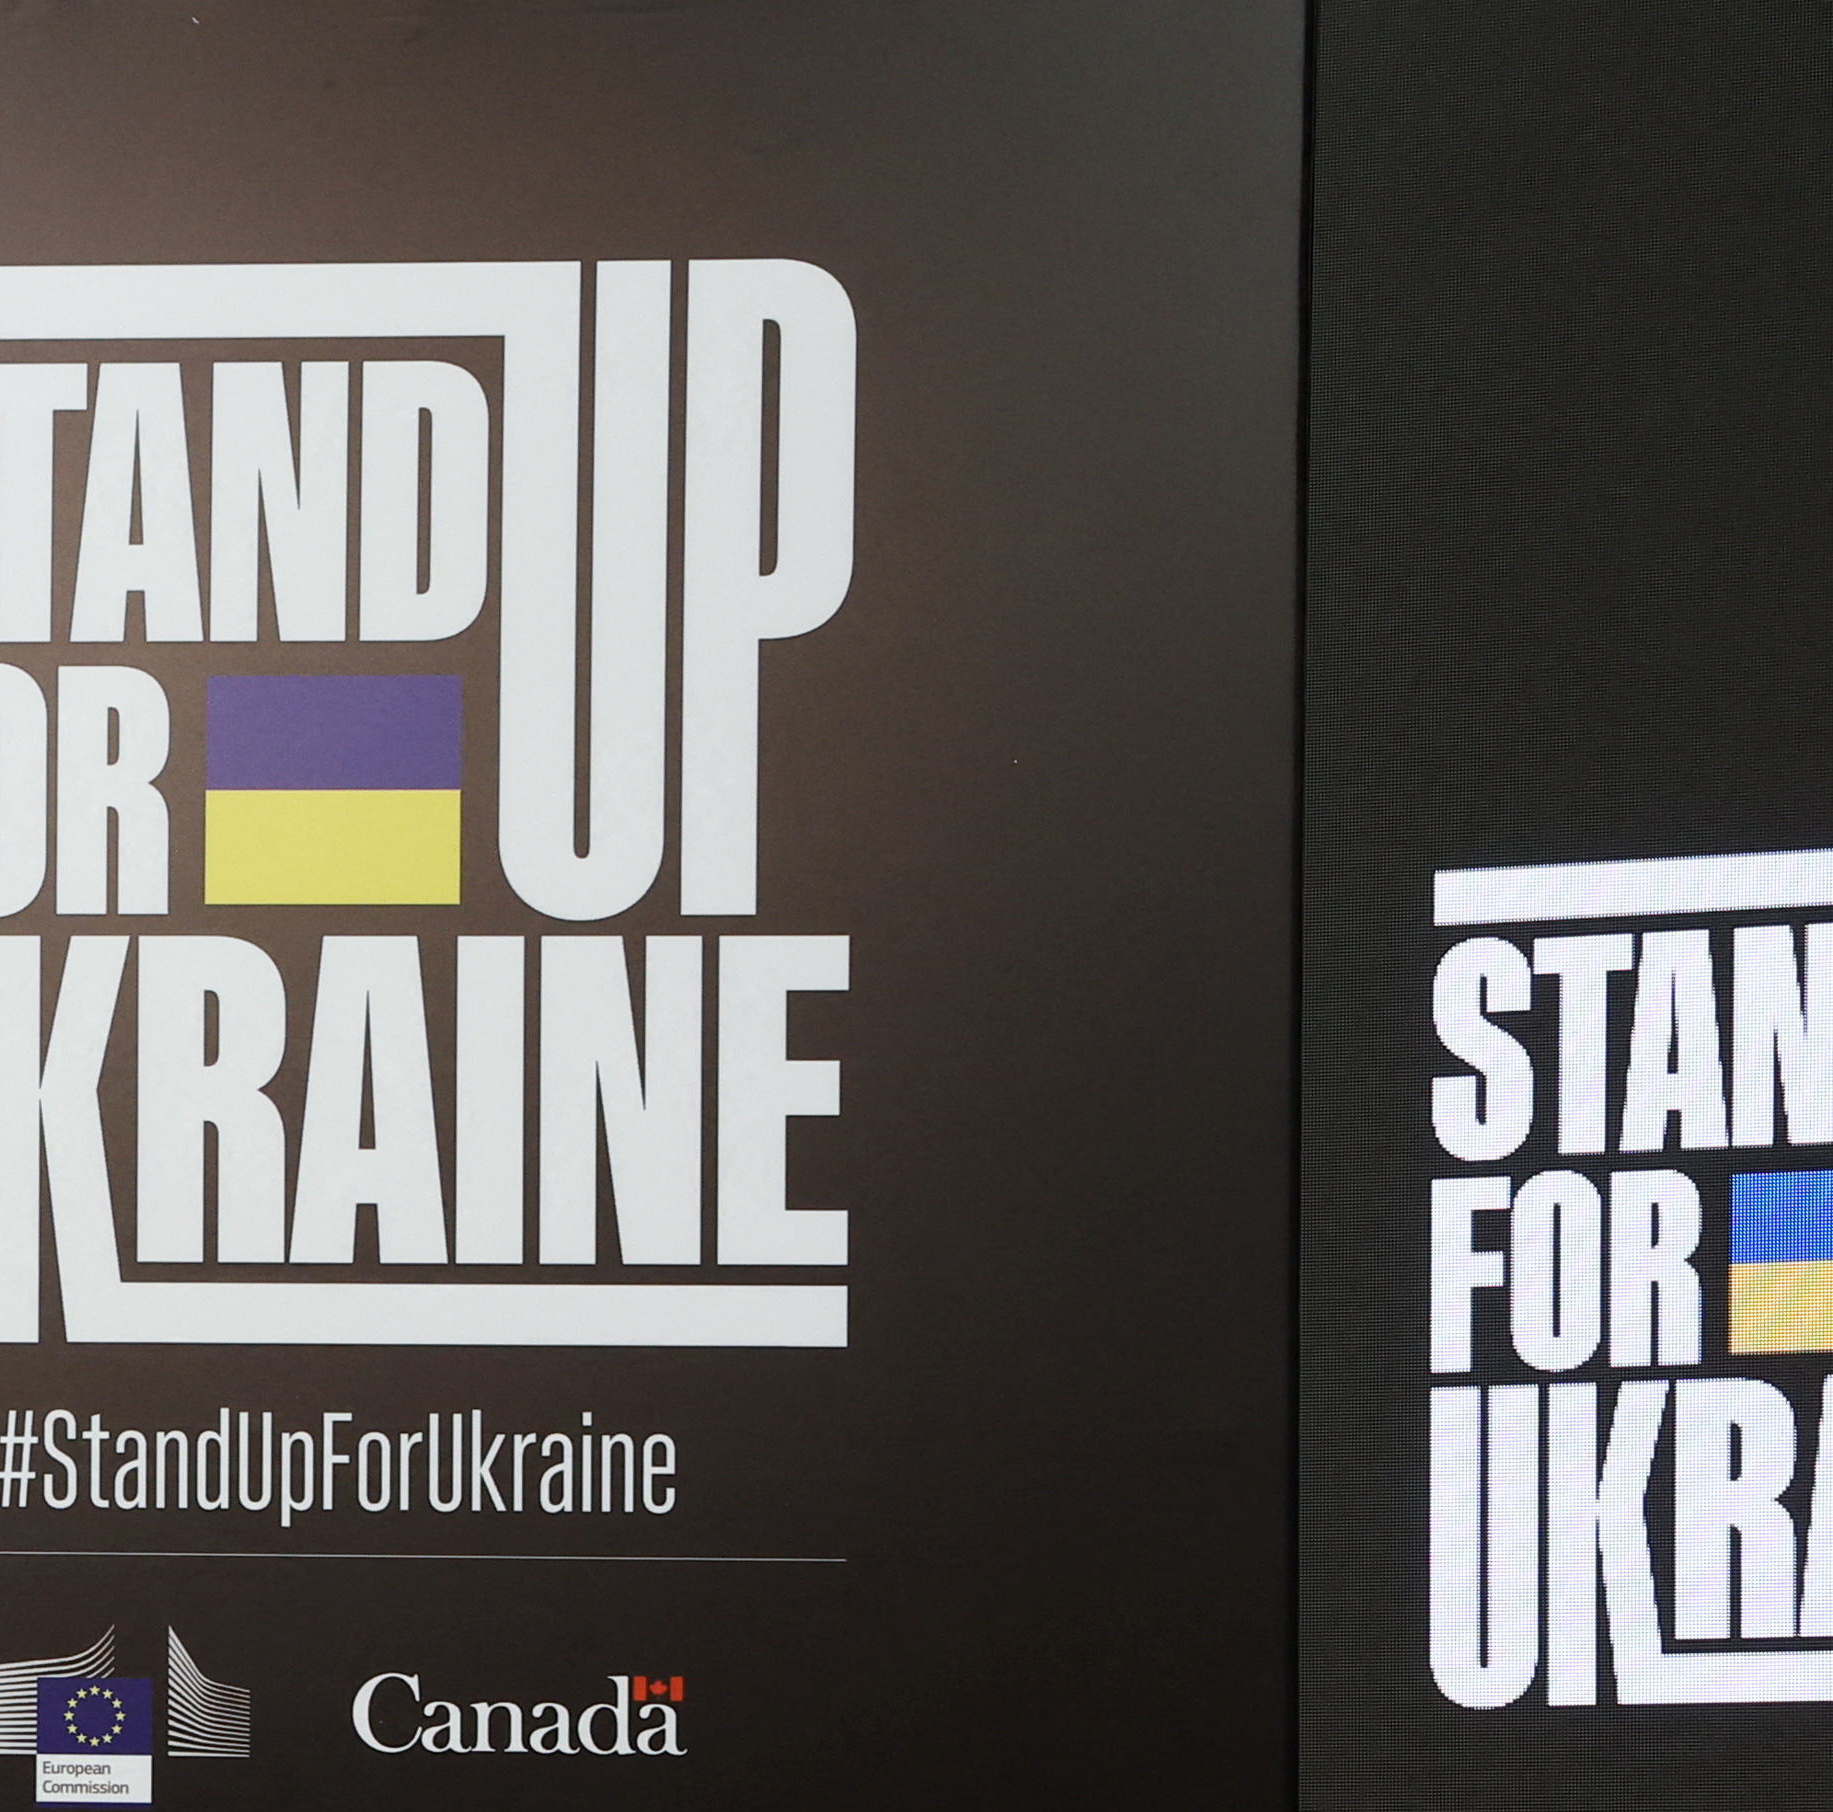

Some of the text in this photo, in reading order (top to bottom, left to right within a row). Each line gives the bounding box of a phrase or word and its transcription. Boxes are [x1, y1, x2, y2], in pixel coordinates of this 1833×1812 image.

[497, 257, 858, 922] UP
[1429, 1168, 1703, 1375] FOR
[1428, 1370, 1833, 1710] UKR
[42, 1761, 111, 1777] European
[352, 1673, 687, 1756] Canada
[42, 1780, 129, 1795] Commission
